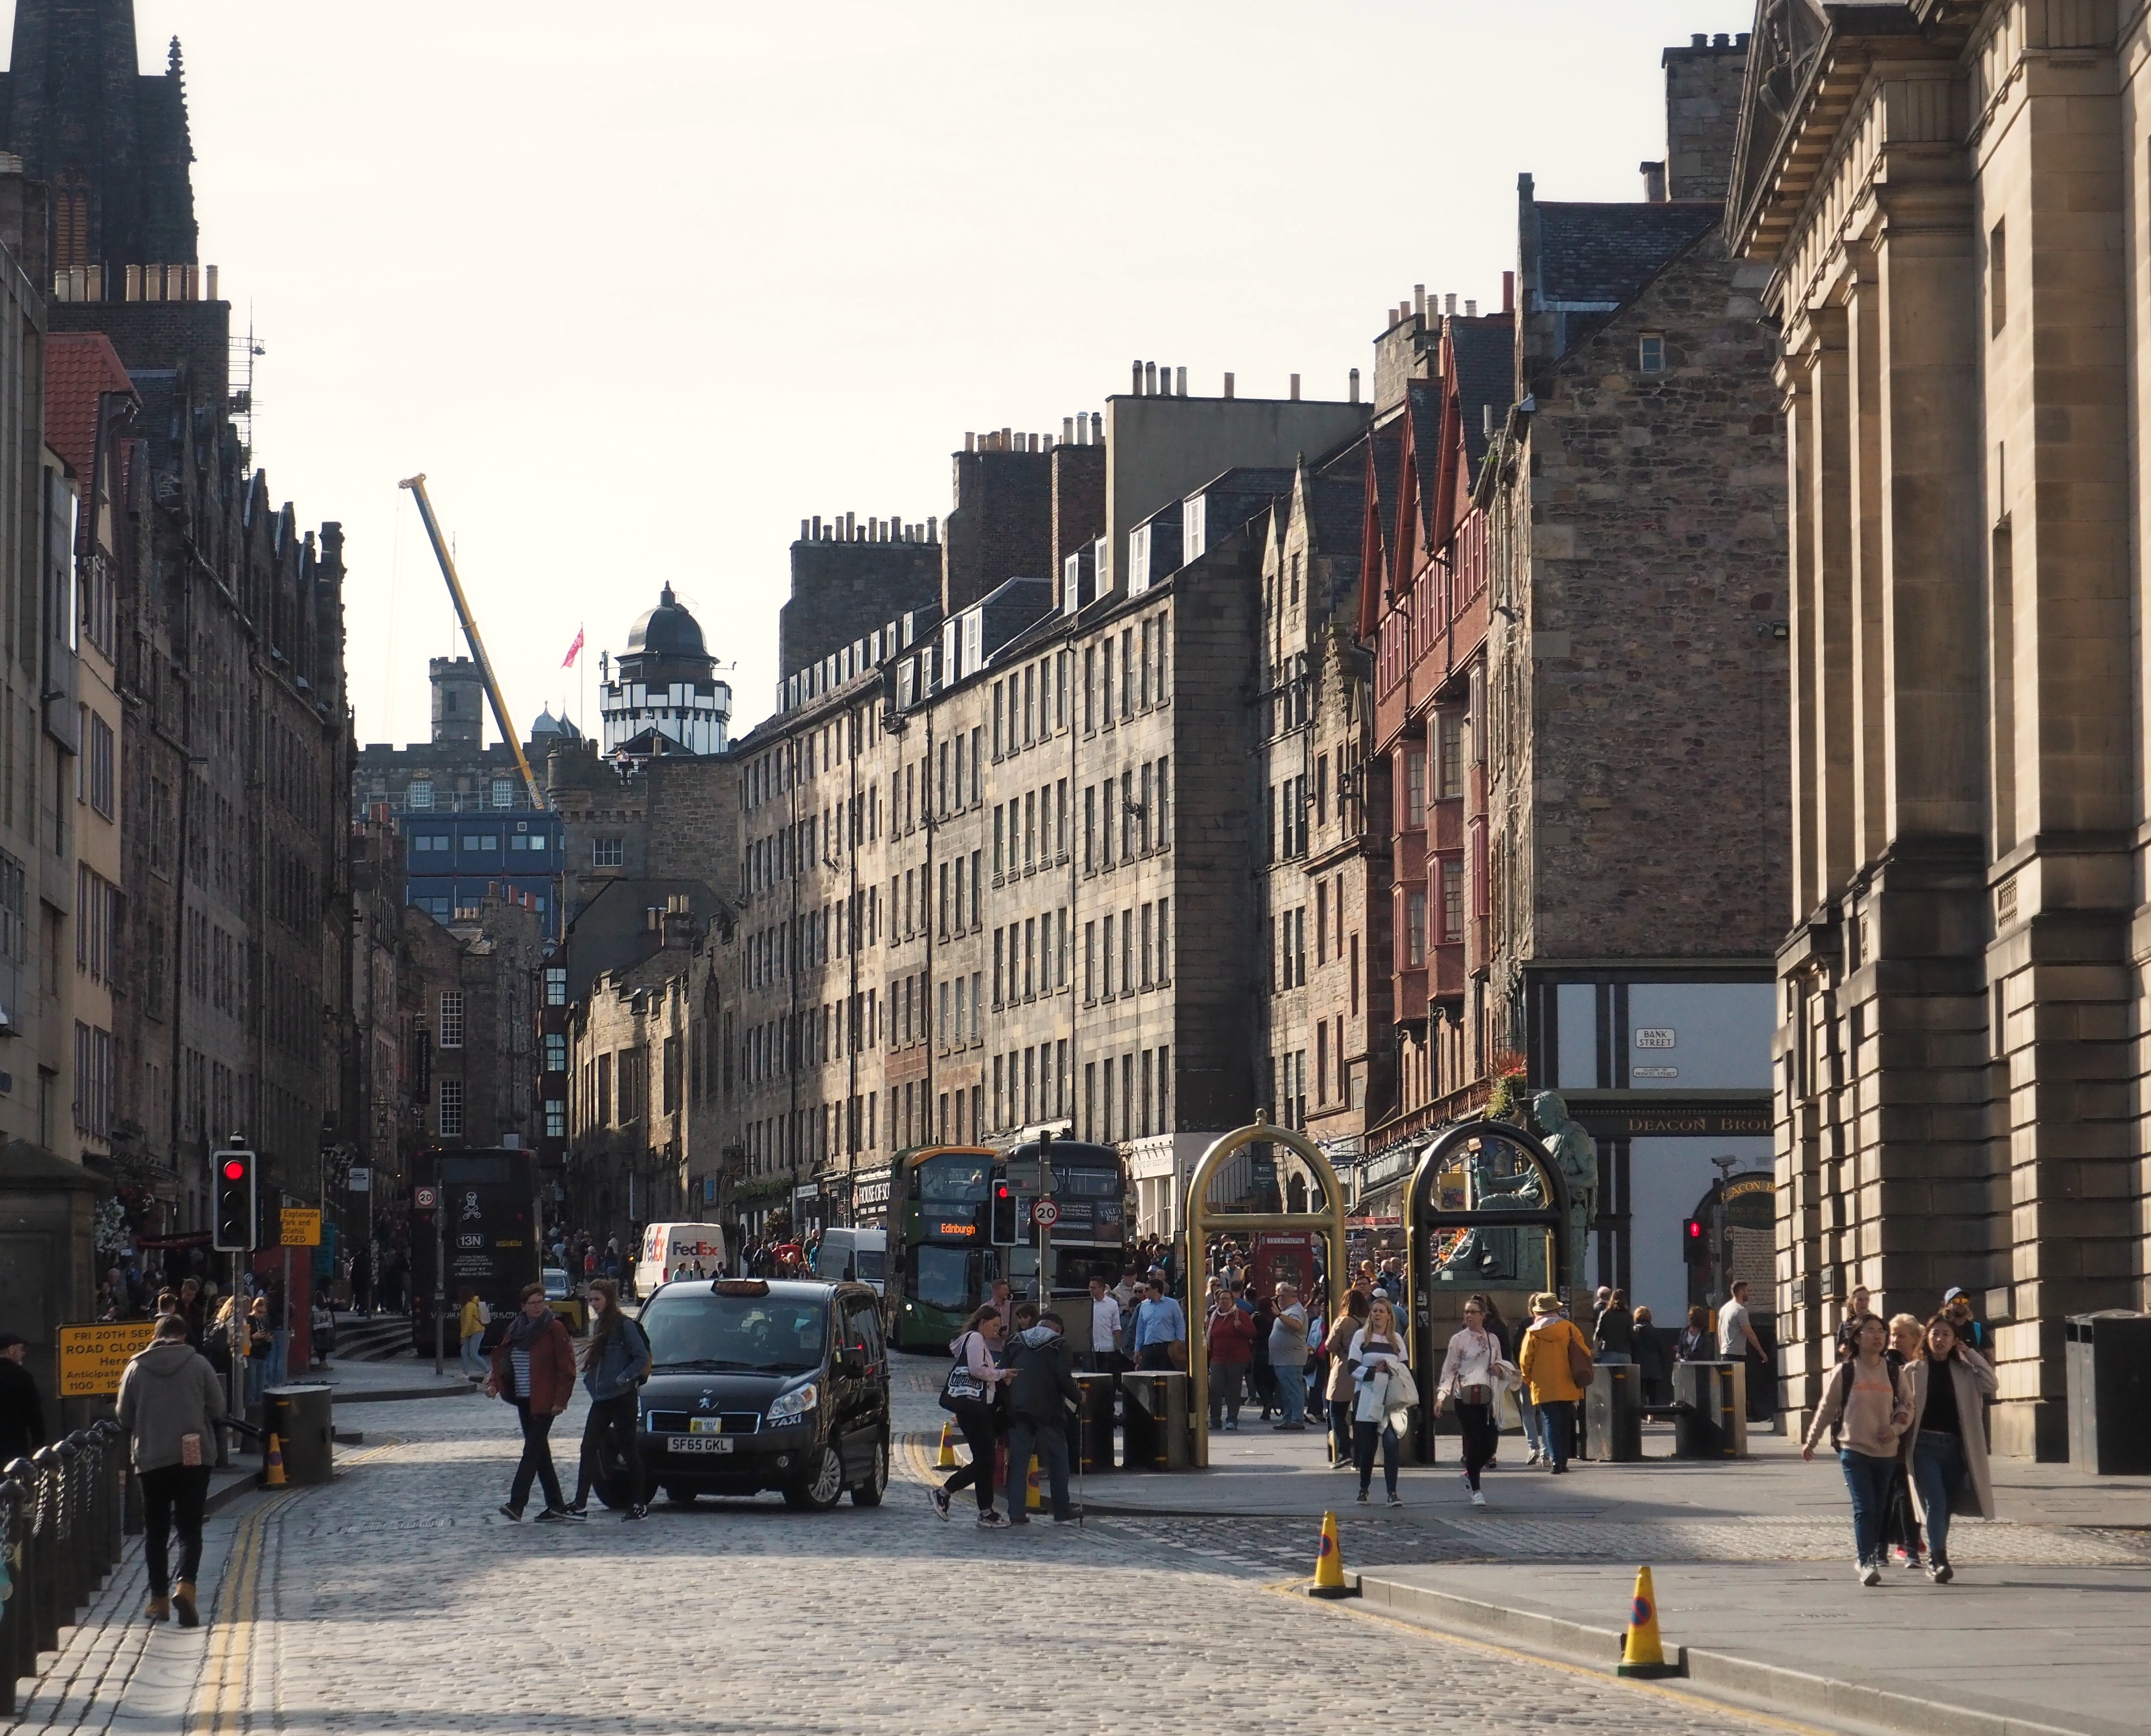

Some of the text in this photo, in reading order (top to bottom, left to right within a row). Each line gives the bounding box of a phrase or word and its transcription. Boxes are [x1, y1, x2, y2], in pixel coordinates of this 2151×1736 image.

[475, 638, 495, 687] BERNARD HUNTER
[526, 780, 540, 806] BERNARD
[1629, 1118, 1706, 1131] DEACON
[1153, 1158, 1172, 1166] SCOTLAND
[859, 1185, 876, 1204] HOUSE
[875, 1184, 883, 1201] OF
[284, 1210, 317, 1218] Esplanade
[1037, 1207, 1055, 1219] 20
[941, 1223, 976, 1236] Edinburgh
[460, 1236, 481, 1246] 13N
[673, 1241, 718, 1256] FedEx
[74, 1332, 91, 1341] FRI
[96, 1331, 125, 1340] 20TH
[66, 1344, 104, 1354] ROAD
[100, 1357, 129, 1366] Here
[67, 1370, 124, 1379] Anticipate
[69, 1382, 93, 1390] 1100
[770, 1413, 802, 1427] TAXI
[672, 1439, 727, 1451] SF65 GKL
